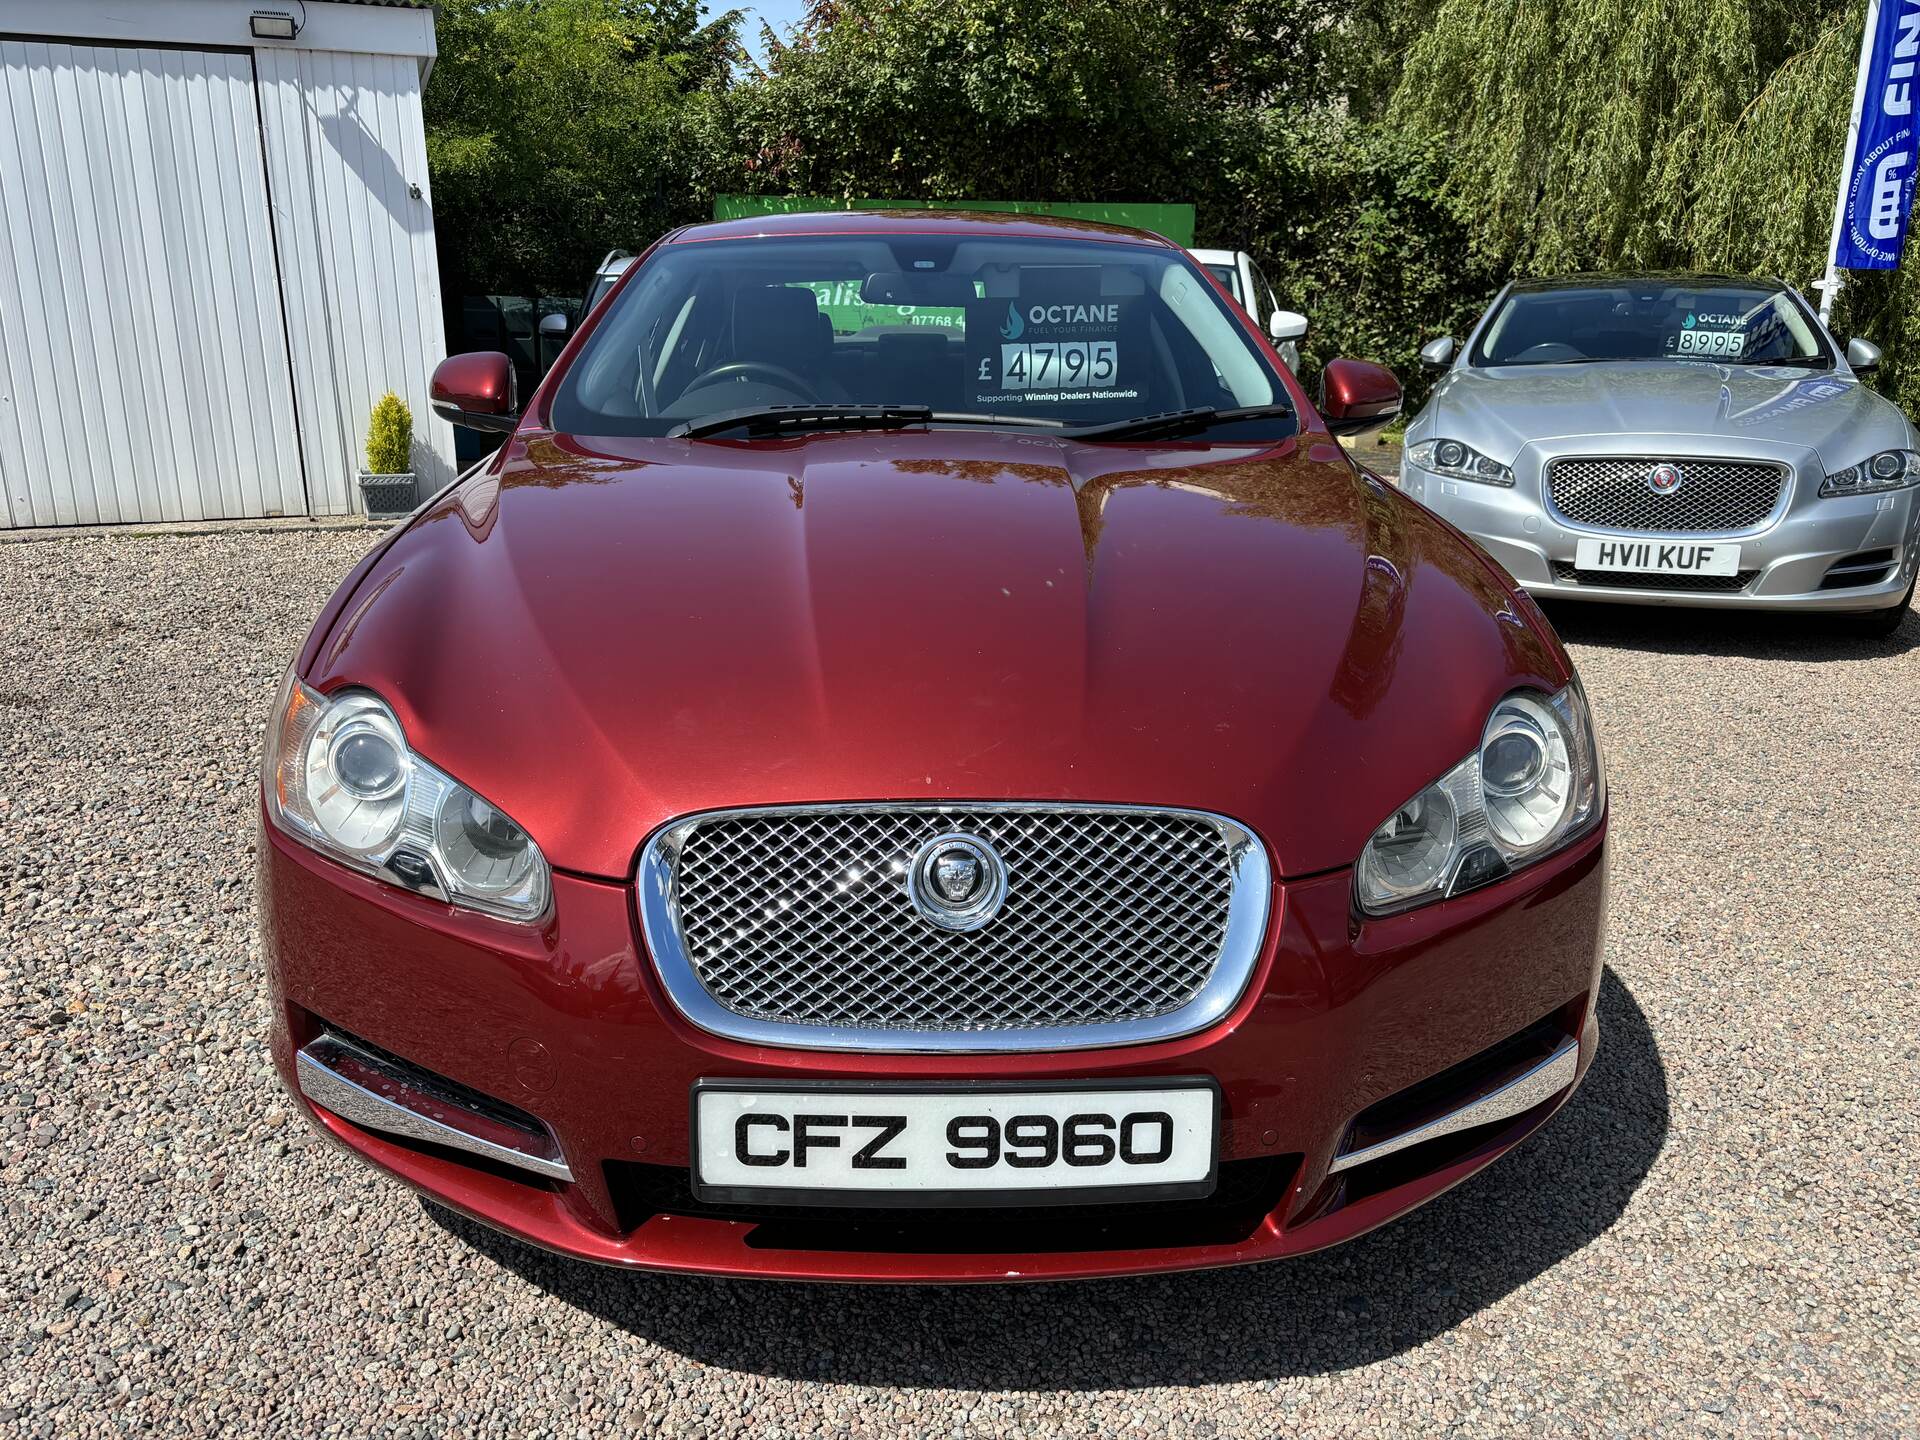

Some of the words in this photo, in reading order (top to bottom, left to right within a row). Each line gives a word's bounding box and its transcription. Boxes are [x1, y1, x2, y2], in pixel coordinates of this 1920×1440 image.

[1883, 0, 1920, 116] FIN
[1850, 165, 1866, 198] TODAY
[1864, 136, 1894, 167] ABOUT
[912, 315, 951, 327] 07768
[1029, 304, 1119, 324] OCTANE
[1698, 313, 1748, 325] OCTANE
[1028, 326, 1049, 334] FUEL
[1053, 326, 1077, 334] YOUR
[1080, 325, 1118, 333] FINANCE
[1665, 336, 1674, 348] £
[1681, 333, 1741, 353] 8995
[978, 357, 992, 380] £
[1006, 347, 1113, 383] 4795
[976, 394, 1023, 403] Supporting
[1025, 392, 1059, 401] Winning
[1061, 391, 1091, 400] Dealers
[1092, 389, 1138, 399] Nationwide
[1657, 545, 1715, 570] KUF
[734, 1112, 907, 1169] CFZ
[945, 1111, 1173, 1169] 9960
